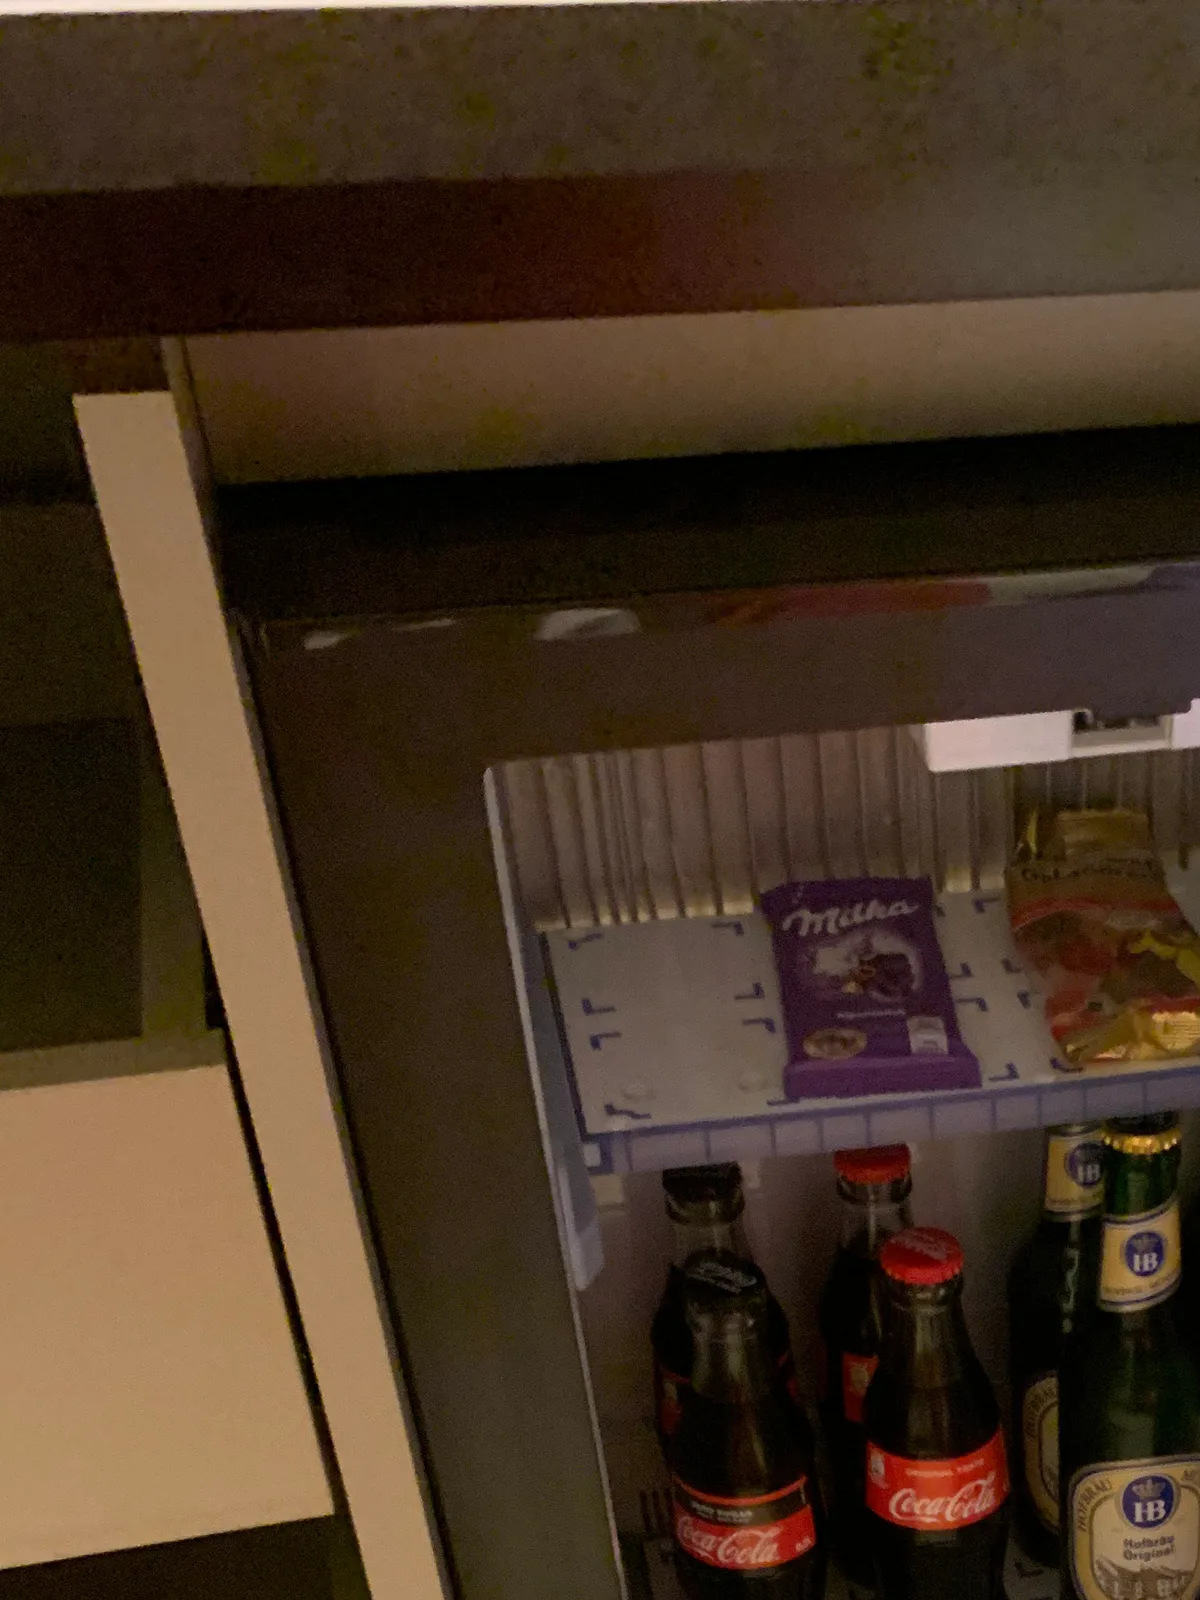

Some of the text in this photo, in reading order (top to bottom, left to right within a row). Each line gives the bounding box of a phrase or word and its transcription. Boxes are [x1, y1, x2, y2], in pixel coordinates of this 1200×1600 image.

[781, 899, 919, 937] Milka
[888, 1470, 997, 1523] Coca-Cola
[1133, 1500, 1166, 1523] HB
[677, 1515, 783, 1564] Coca-Cola
